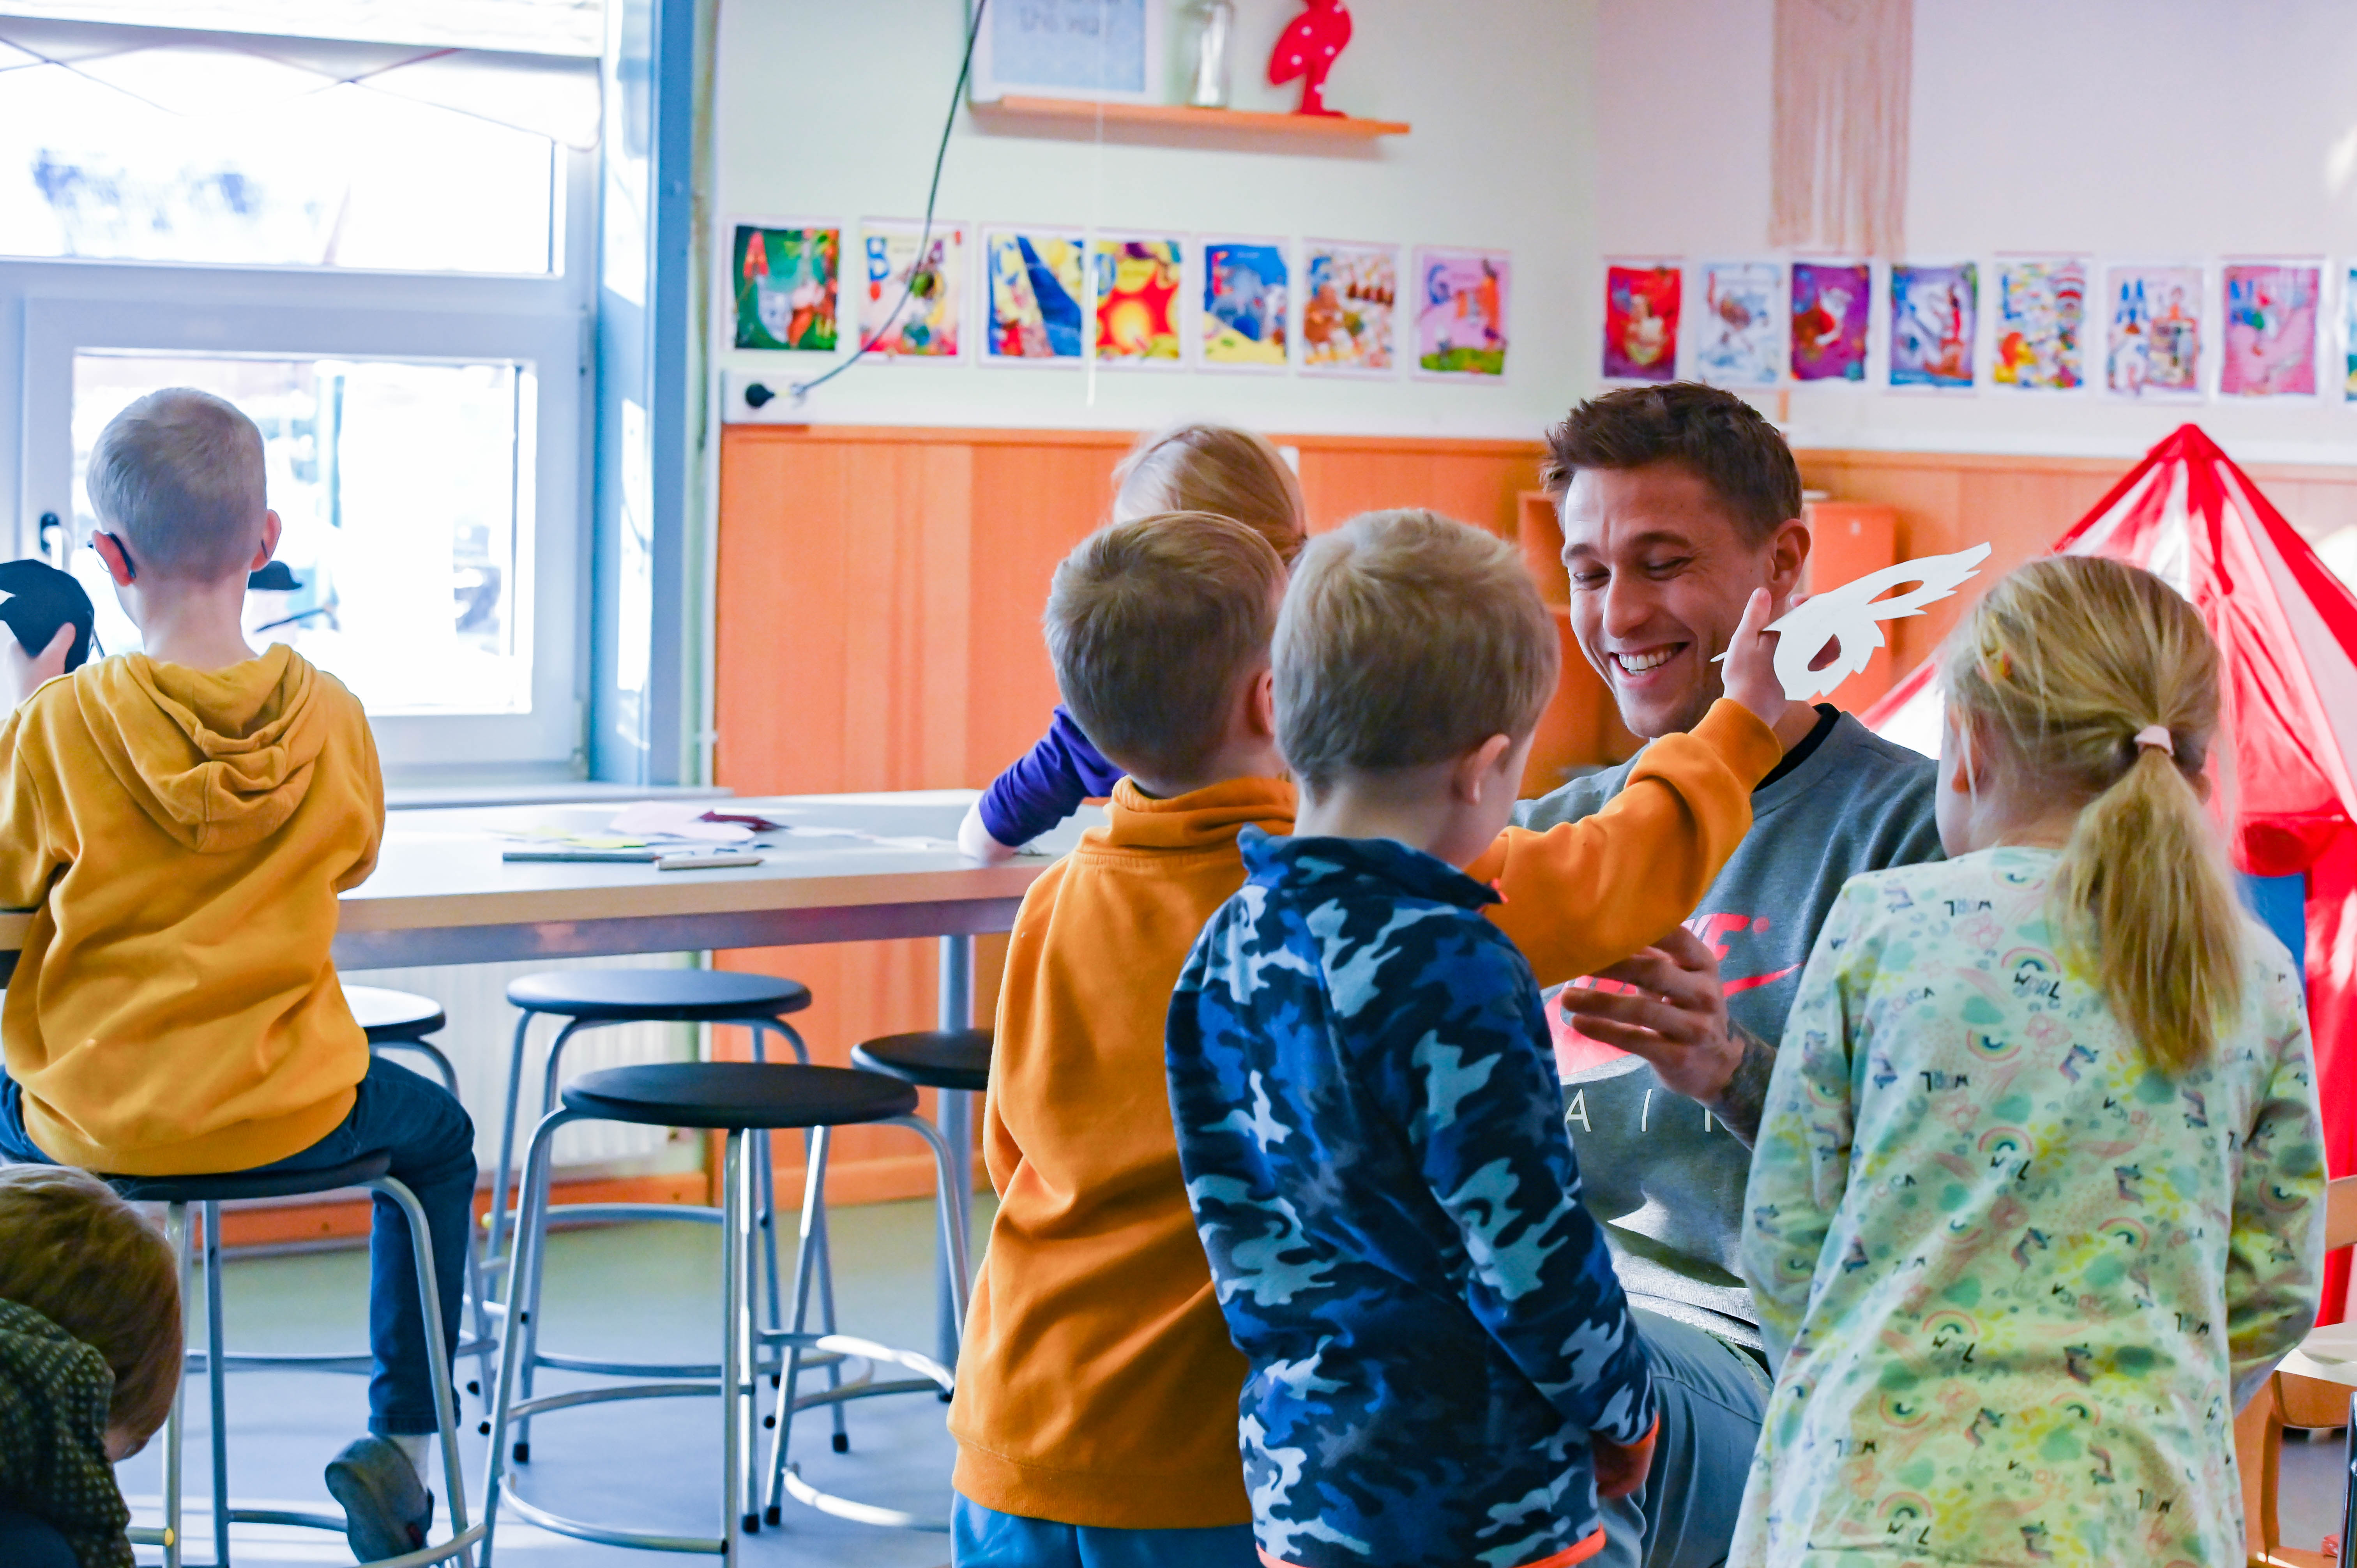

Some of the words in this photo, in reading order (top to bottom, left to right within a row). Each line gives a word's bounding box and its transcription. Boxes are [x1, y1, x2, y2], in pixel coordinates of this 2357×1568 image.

[743, 231, 768, 278] A
[866, 237, 892, 281] B
[995, 241, 1019, 286] C
[1211, 251, 1234, 297] E
[1428, 264, 1450, 305] G
[1564, 1088, 1711, 1132] AI
